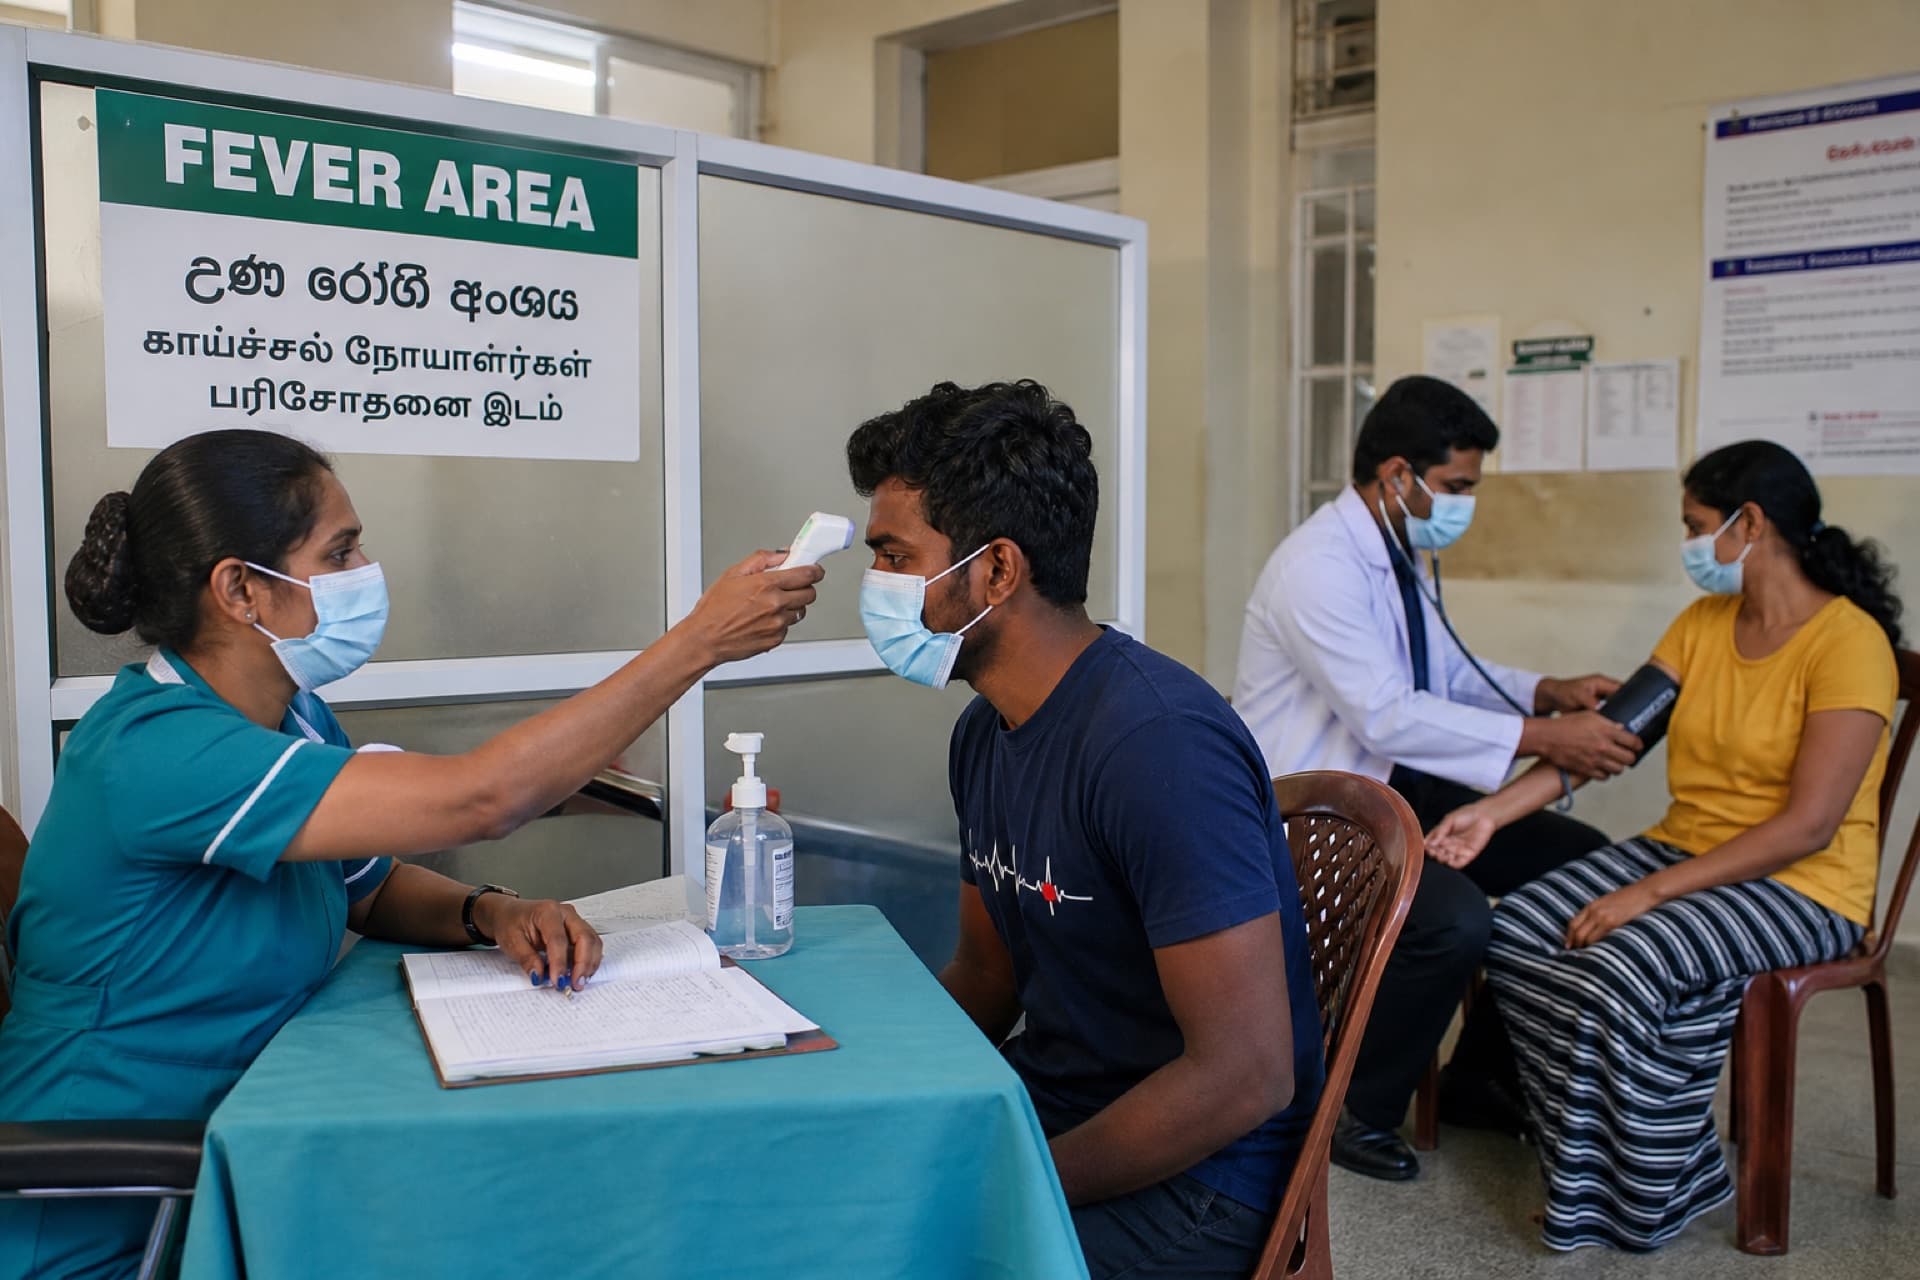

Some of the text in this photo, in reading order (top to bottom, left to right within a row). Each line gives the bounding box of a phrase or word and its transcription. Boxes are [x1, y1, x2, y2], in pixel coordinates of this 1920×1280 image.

[163, 122, 596, 232] FEVER AREA
[185, 254, 285, 305] උණ
[450, 279, 579, 321] අංශය
[143, 325, 334, 364] காய்ச்சல்
[210, 377, 563, 427] பரிசோதனை இடம்
